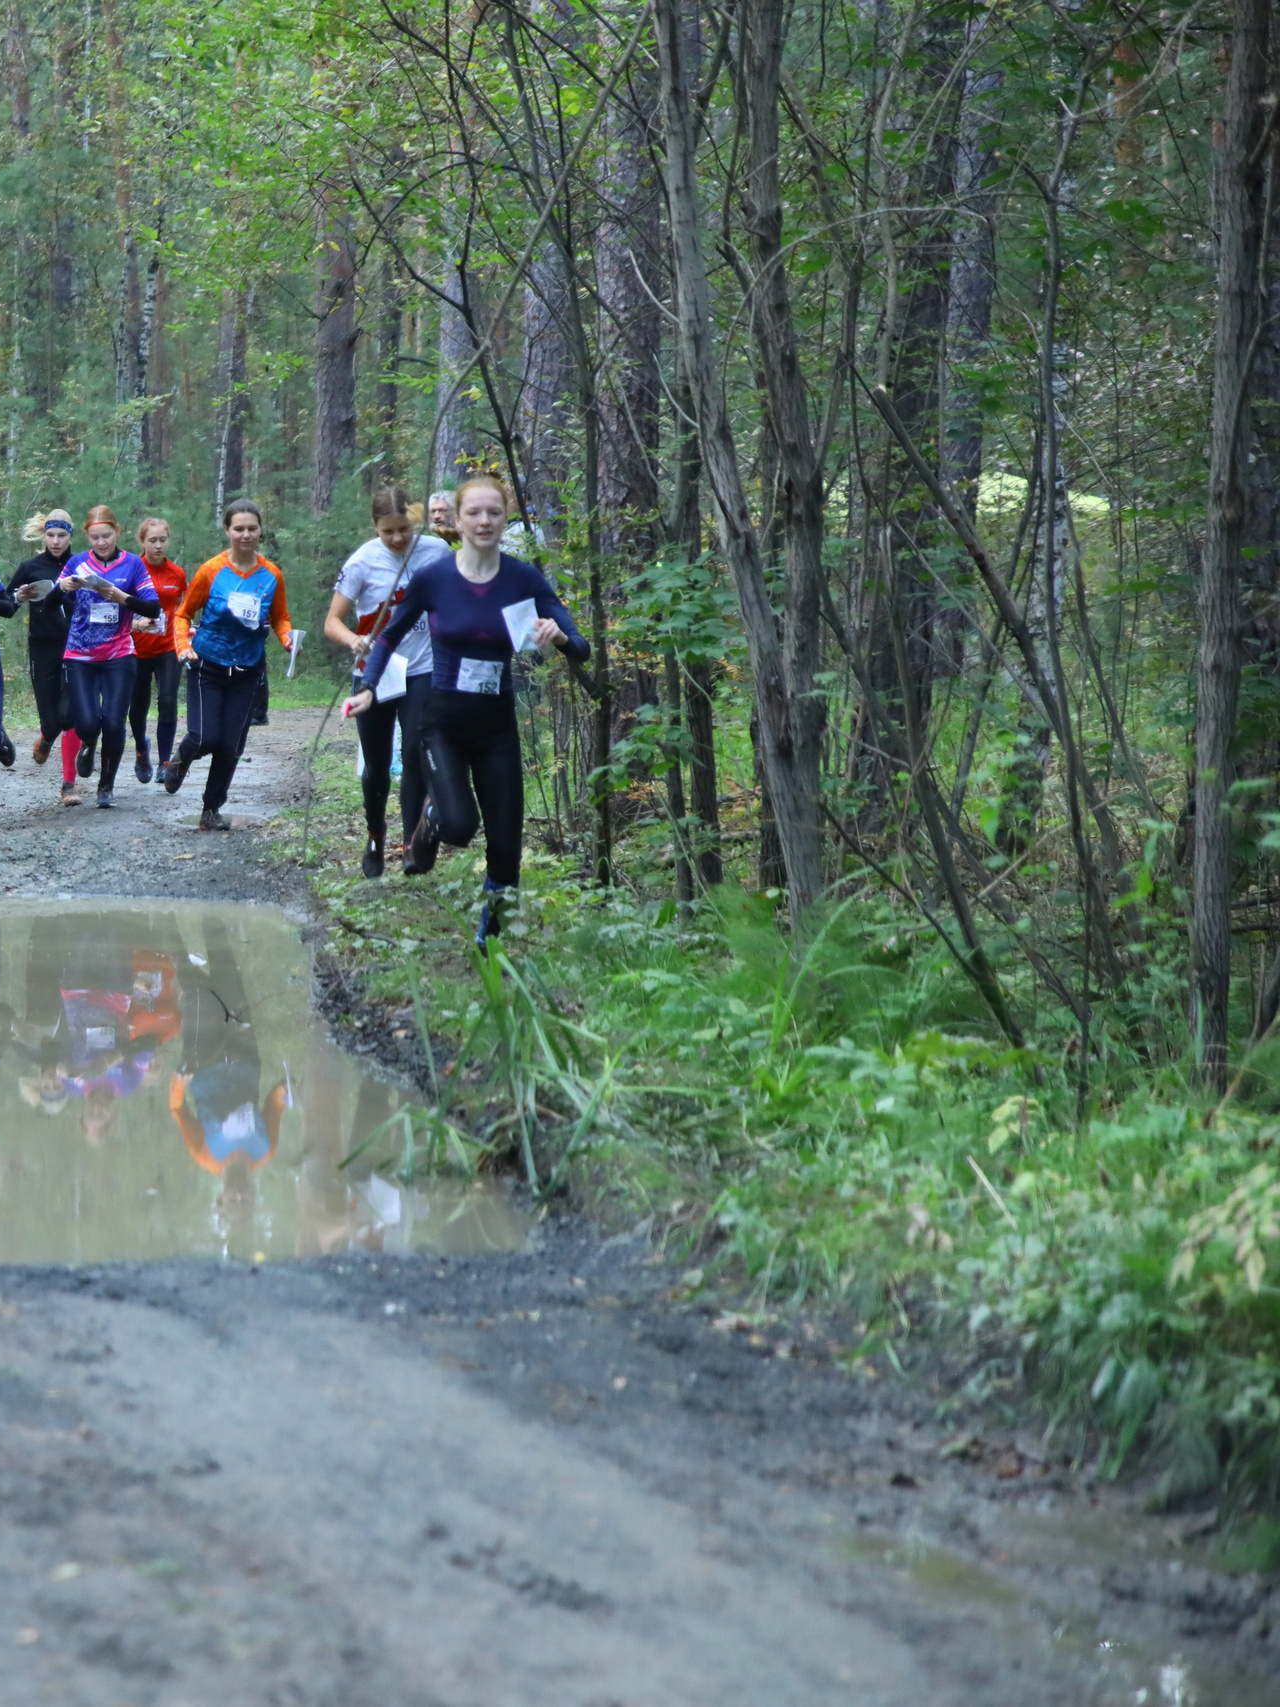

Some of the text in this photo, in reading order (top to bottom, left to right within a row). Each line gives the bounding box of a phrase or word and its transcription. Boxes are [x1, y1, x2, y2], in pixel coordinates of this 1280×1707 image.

[103, 614, 118, 622] 155
[242, 608, 257, 618] 157
[409, 620, 426, 632] 60
[478, 681, 498, 694] 152
